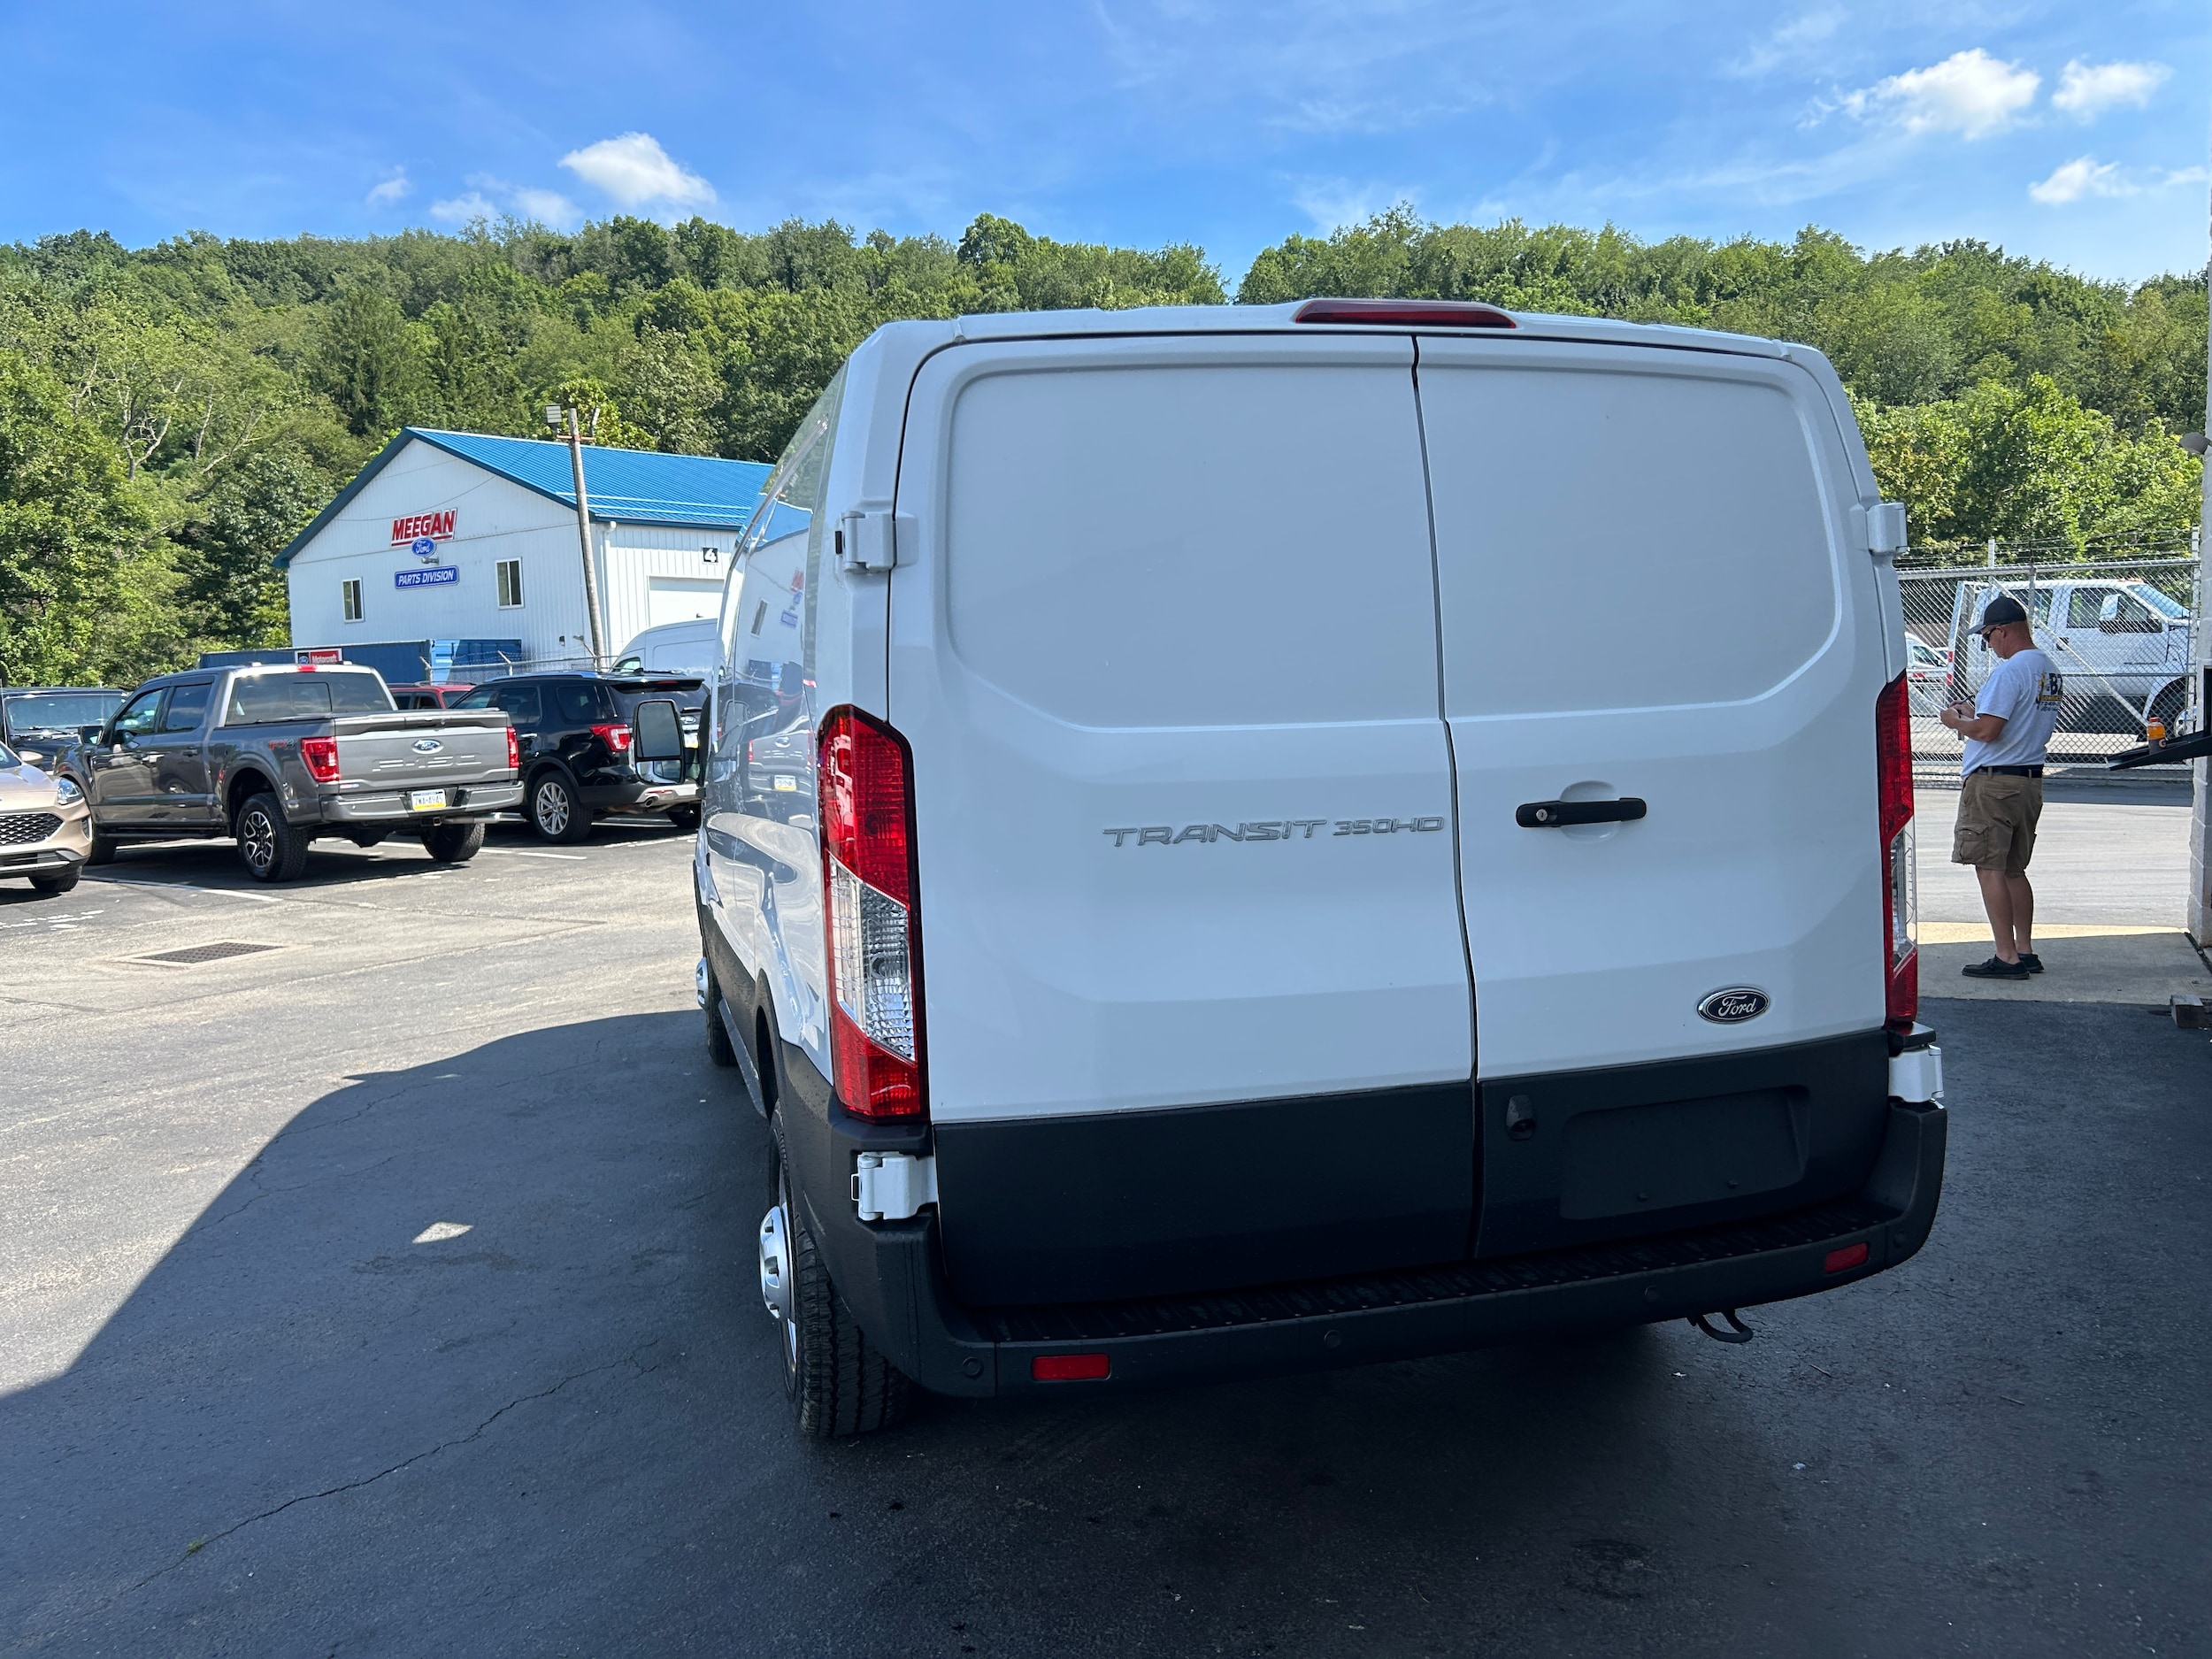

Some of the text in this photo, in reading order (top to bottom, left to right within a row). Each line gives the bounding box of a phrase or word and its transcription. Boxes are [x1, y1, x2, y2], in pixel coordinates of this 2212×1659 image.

[392, 510, 456, 541] MEEGAN
[704, 548, 717, 563] 4
[397, 569, 454, 586] PARTS DIVISION
[1102, 816, 1445, 847] TRANSIT 350HD
[1717, 995, 1757, 1017] Ford
